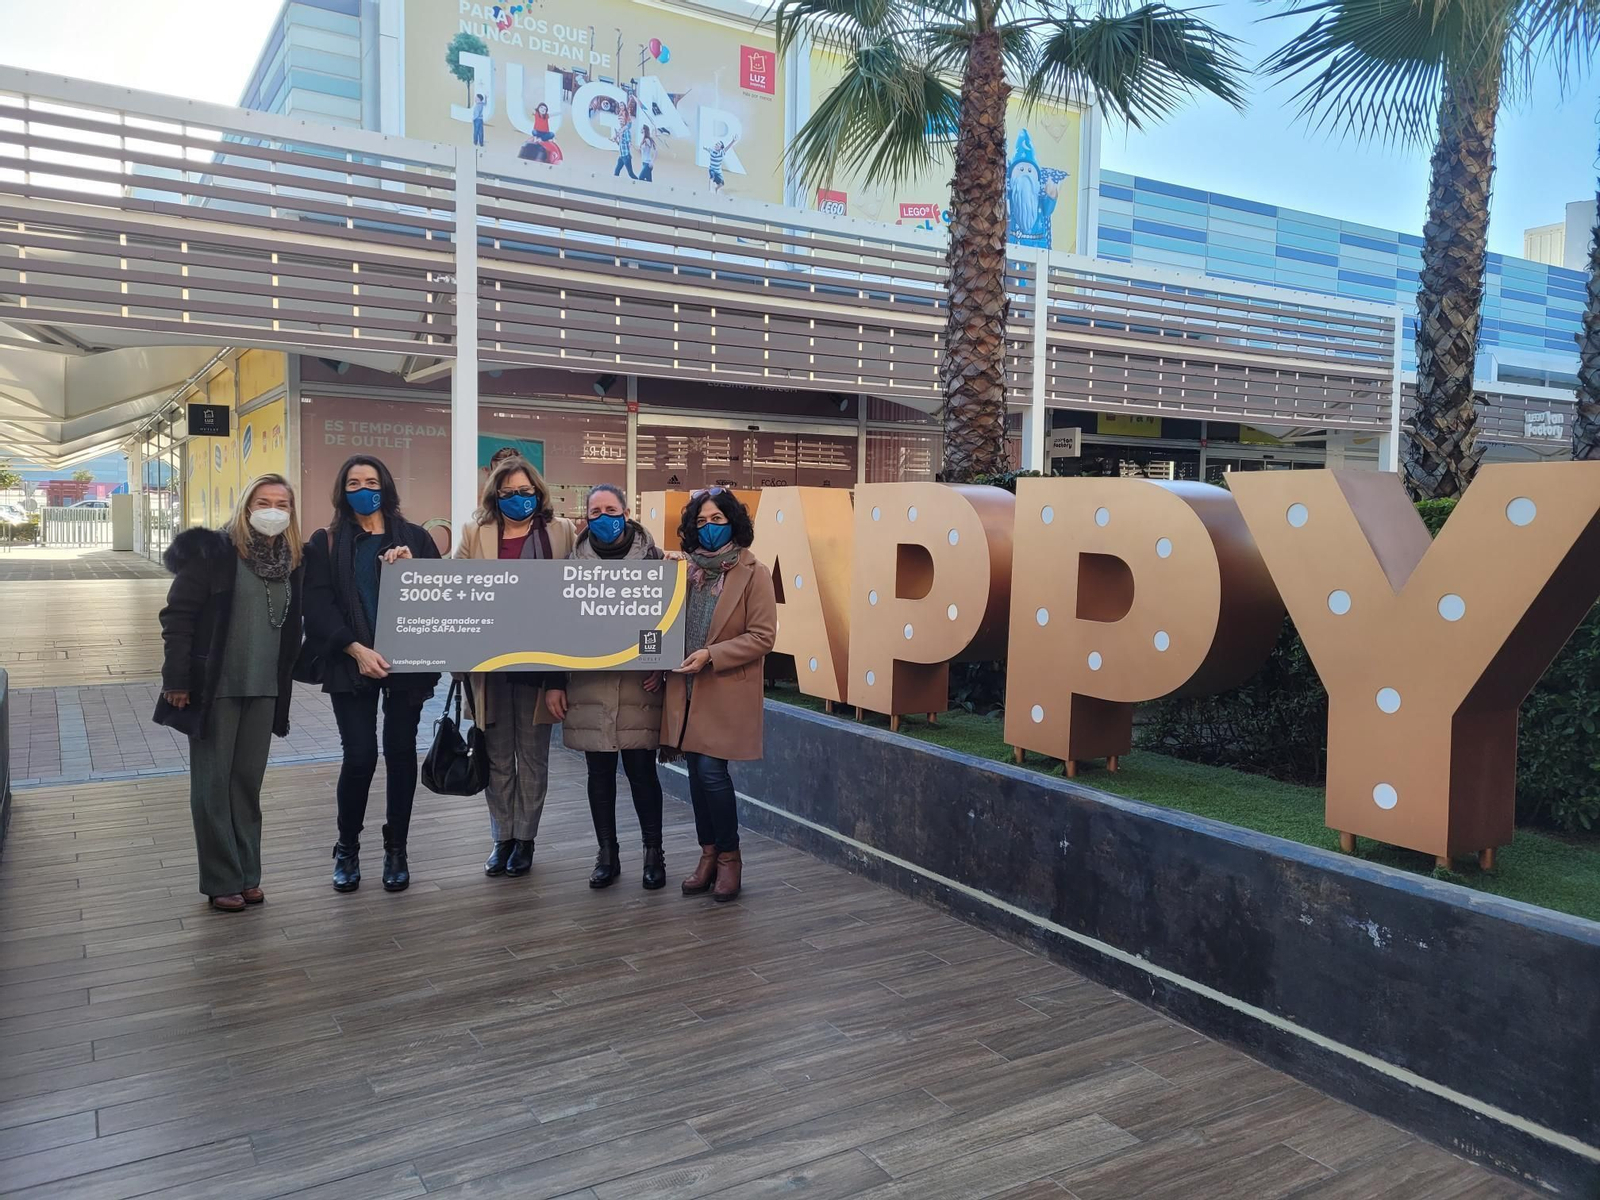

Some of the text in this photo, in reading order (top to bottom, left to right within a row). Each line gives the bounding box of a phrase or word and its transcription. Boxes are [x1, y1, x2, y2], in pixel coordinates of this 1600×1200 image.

[459, 0, 588, 45] PARA LOS QUE
[459, 19, 611, 68] NUNCA DEJAN DE
[749, 73, 766, 84] LUZ
[450, 51, 747, 176] JUGAR
[820, 200, 844, 215] LEGO
[324, 419, 447, 437] ES TEMPORADA
[324, 433, 412, 449] DE OUTLET
[400, 571, 519, 588] Cheque regalo
[562, 565, 664, 582] Disfruta el
[399, 588, 453, 602] 3000€
[470, 588, 495, 602] iva
[562, 583, 663, 599] doble esta
[580, 600, 663, 616] Navidad
[396, 616, 406, 625] El
[407, 617, 439, 627] colegio
[441, 617, 480, 627] ganador
[396, 625, 481, 635] Colegio SAFA Jerez
[392, 658, 447, 667] luzshopping.com
[641, 461, 1600, 858] APPY
